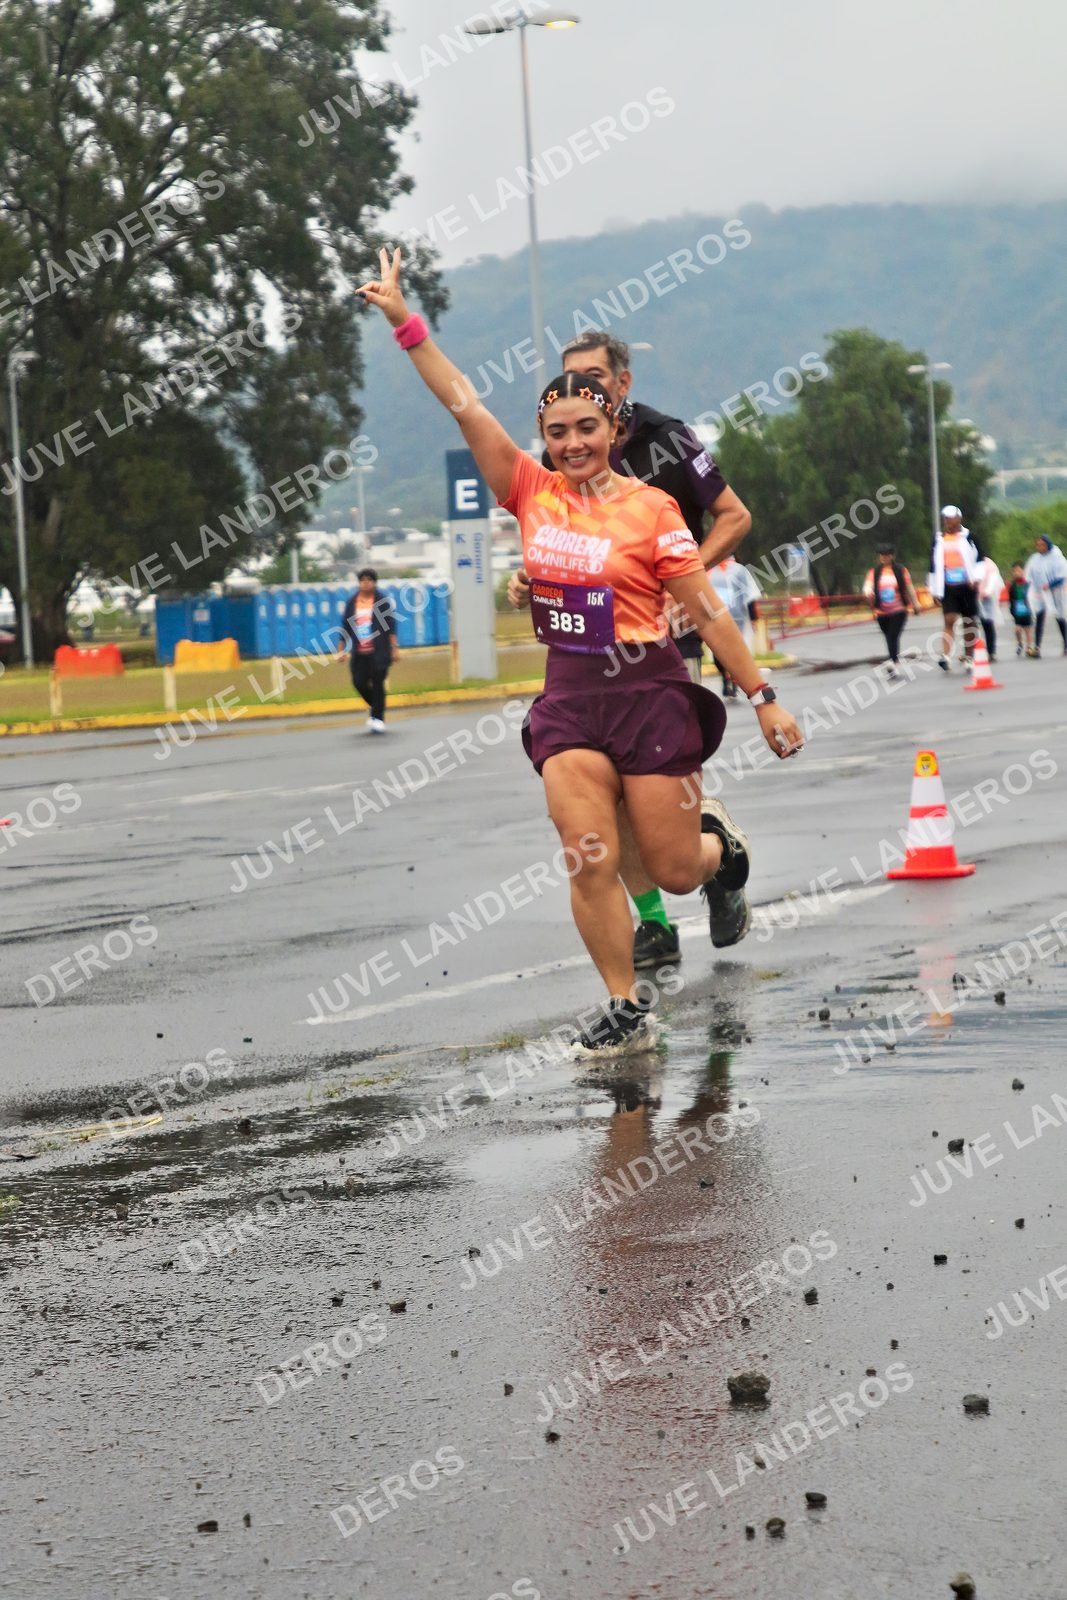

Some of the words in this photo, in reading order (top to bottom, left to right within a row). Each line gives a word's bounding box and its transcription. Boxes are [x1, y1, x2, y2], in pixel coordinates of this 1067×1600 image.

[455, 478, 480, 511] E
[473, 532, 484, 584] General
[533, 524, 612, 560] CARRERA
[528, 546, 586, 572] OMNILIFE
[549, 610, 586, 634] 383
